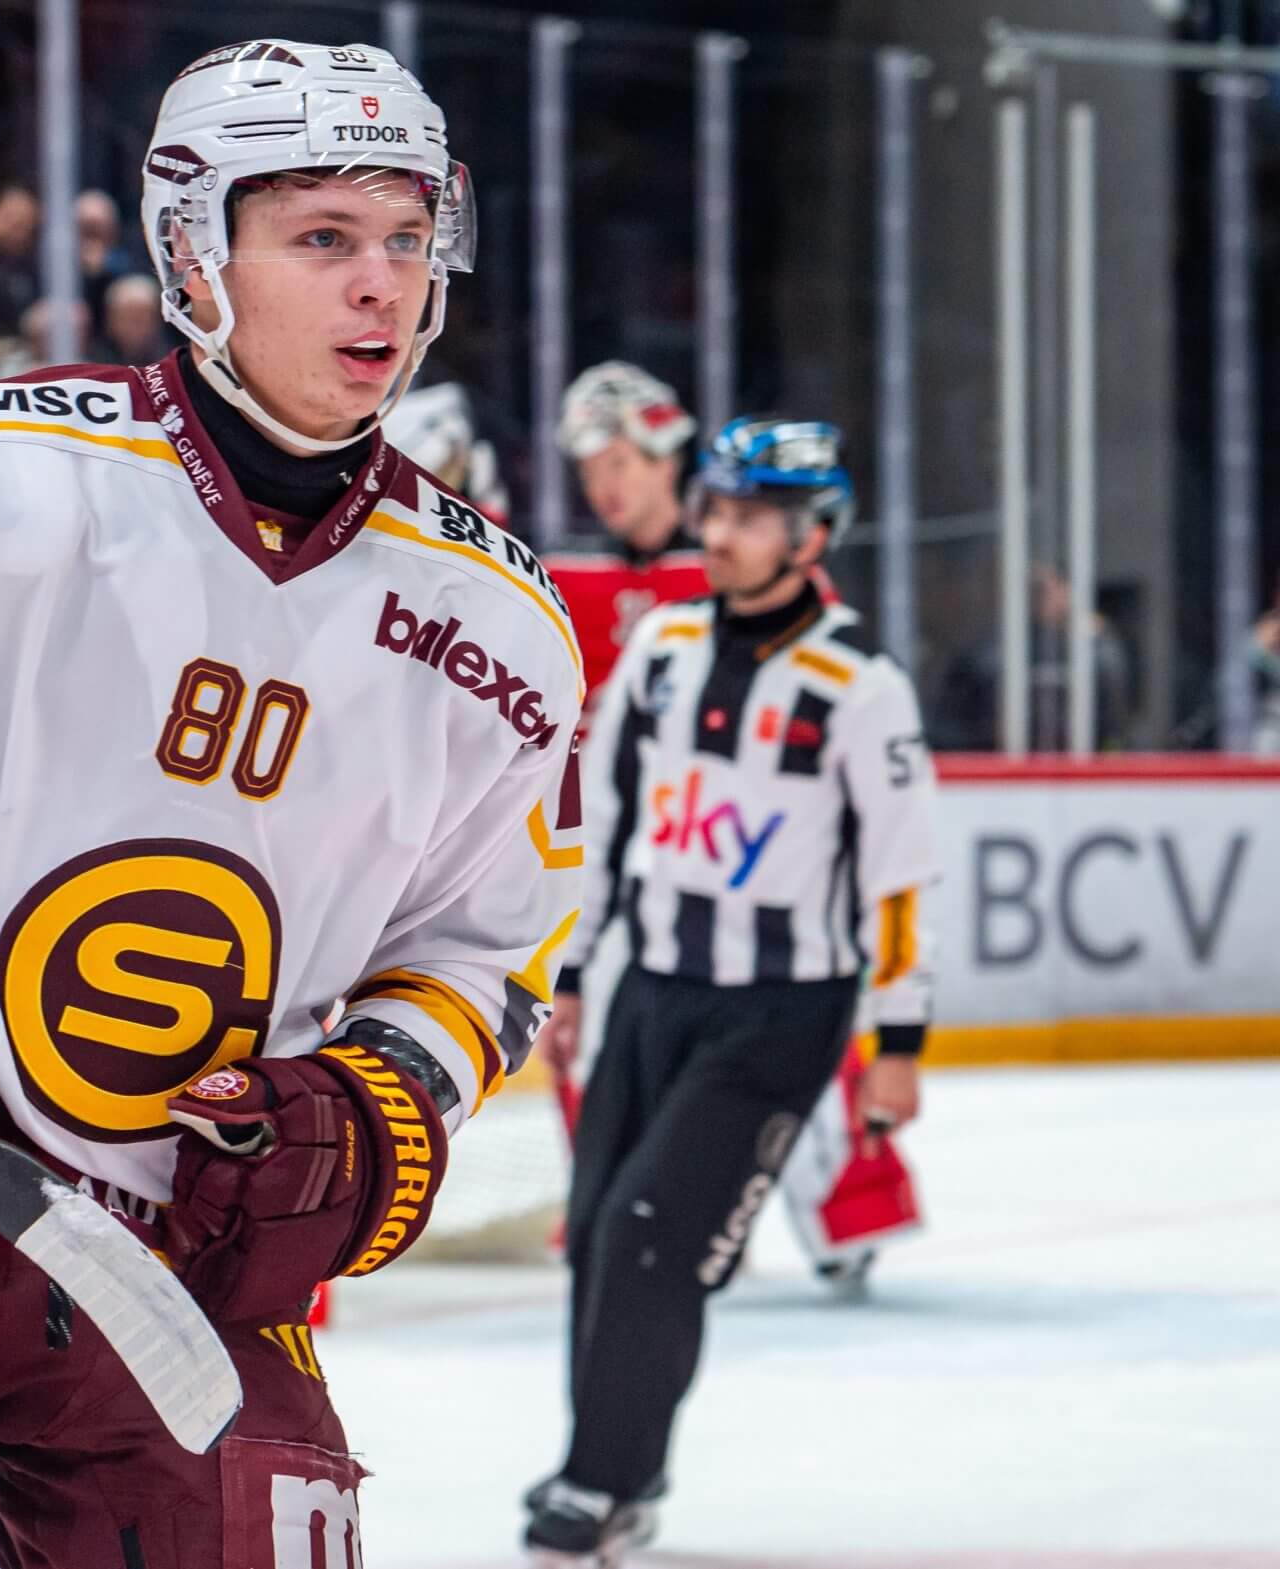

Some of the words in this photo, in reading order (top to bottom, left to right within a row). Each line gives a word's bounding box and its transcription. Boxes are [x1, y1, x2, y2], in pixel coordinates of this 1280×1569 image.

[333, 125, 410, 144] TUDOR
[154, 656, 312, 802] 80
[649, 766, 787, 891] sky
[973, 830, 1251, 971] BCV
